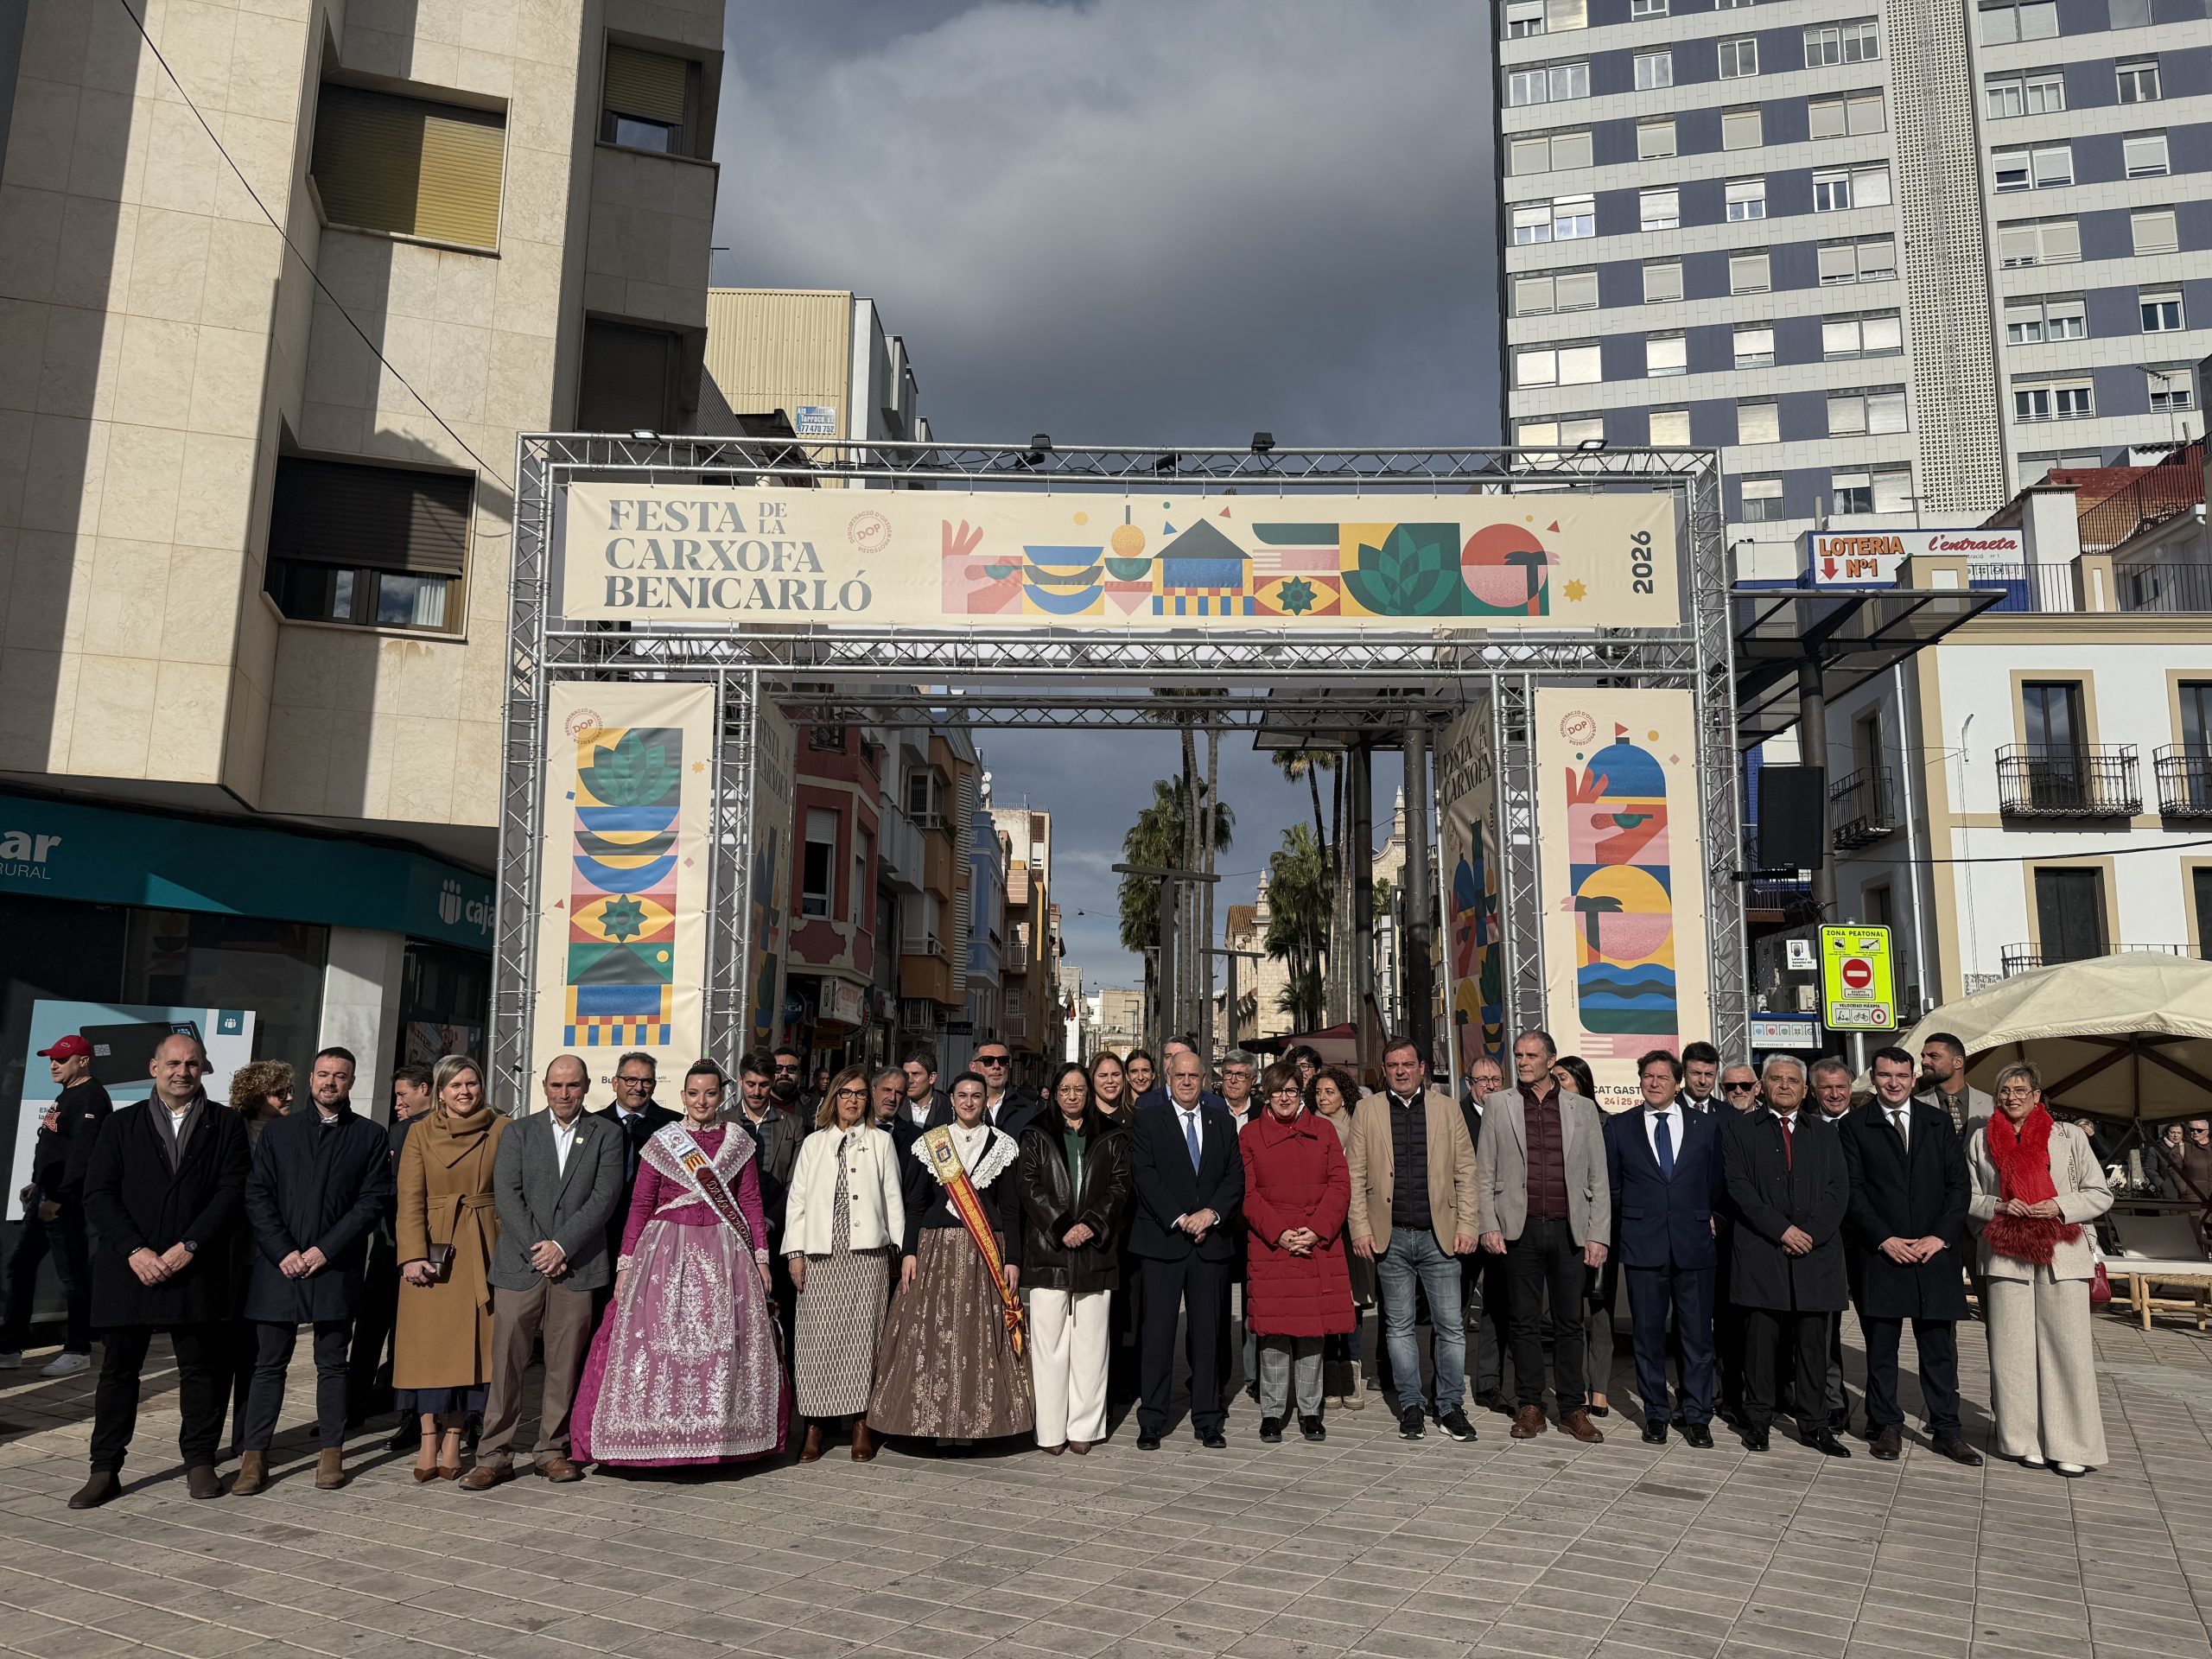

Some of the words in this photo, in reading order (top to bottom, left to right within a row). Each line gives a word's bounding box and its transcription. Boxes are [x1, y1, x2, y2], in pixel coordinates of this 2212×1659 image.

[608, 499, 748, 533] FESTA
[759, 502, 787, 518] DE
[759, 519, 786, 535] LA
[856, 524, 880, 541] DOP
[605, 537, 825, 573] CARXOFA
[1818, 536, 1905, 556] LOTERIA
[1630, 530, 1654, 594] 2026
[604, 569, 873, 613] BENICARLÓ
[572, 719, 594, 734] DOP
[760, 715, 779, 763] FESTA
[1567, 721, 1587, 734] DOP
[1444, 735, 1473, 779] FESTA
[1444, 753, 1492, 806] CARXOFA
[0, 830, 62, 862] ar
[1617, 1096, 1619, 1105] i
[706, 1180, 729, 1211] DAMA
